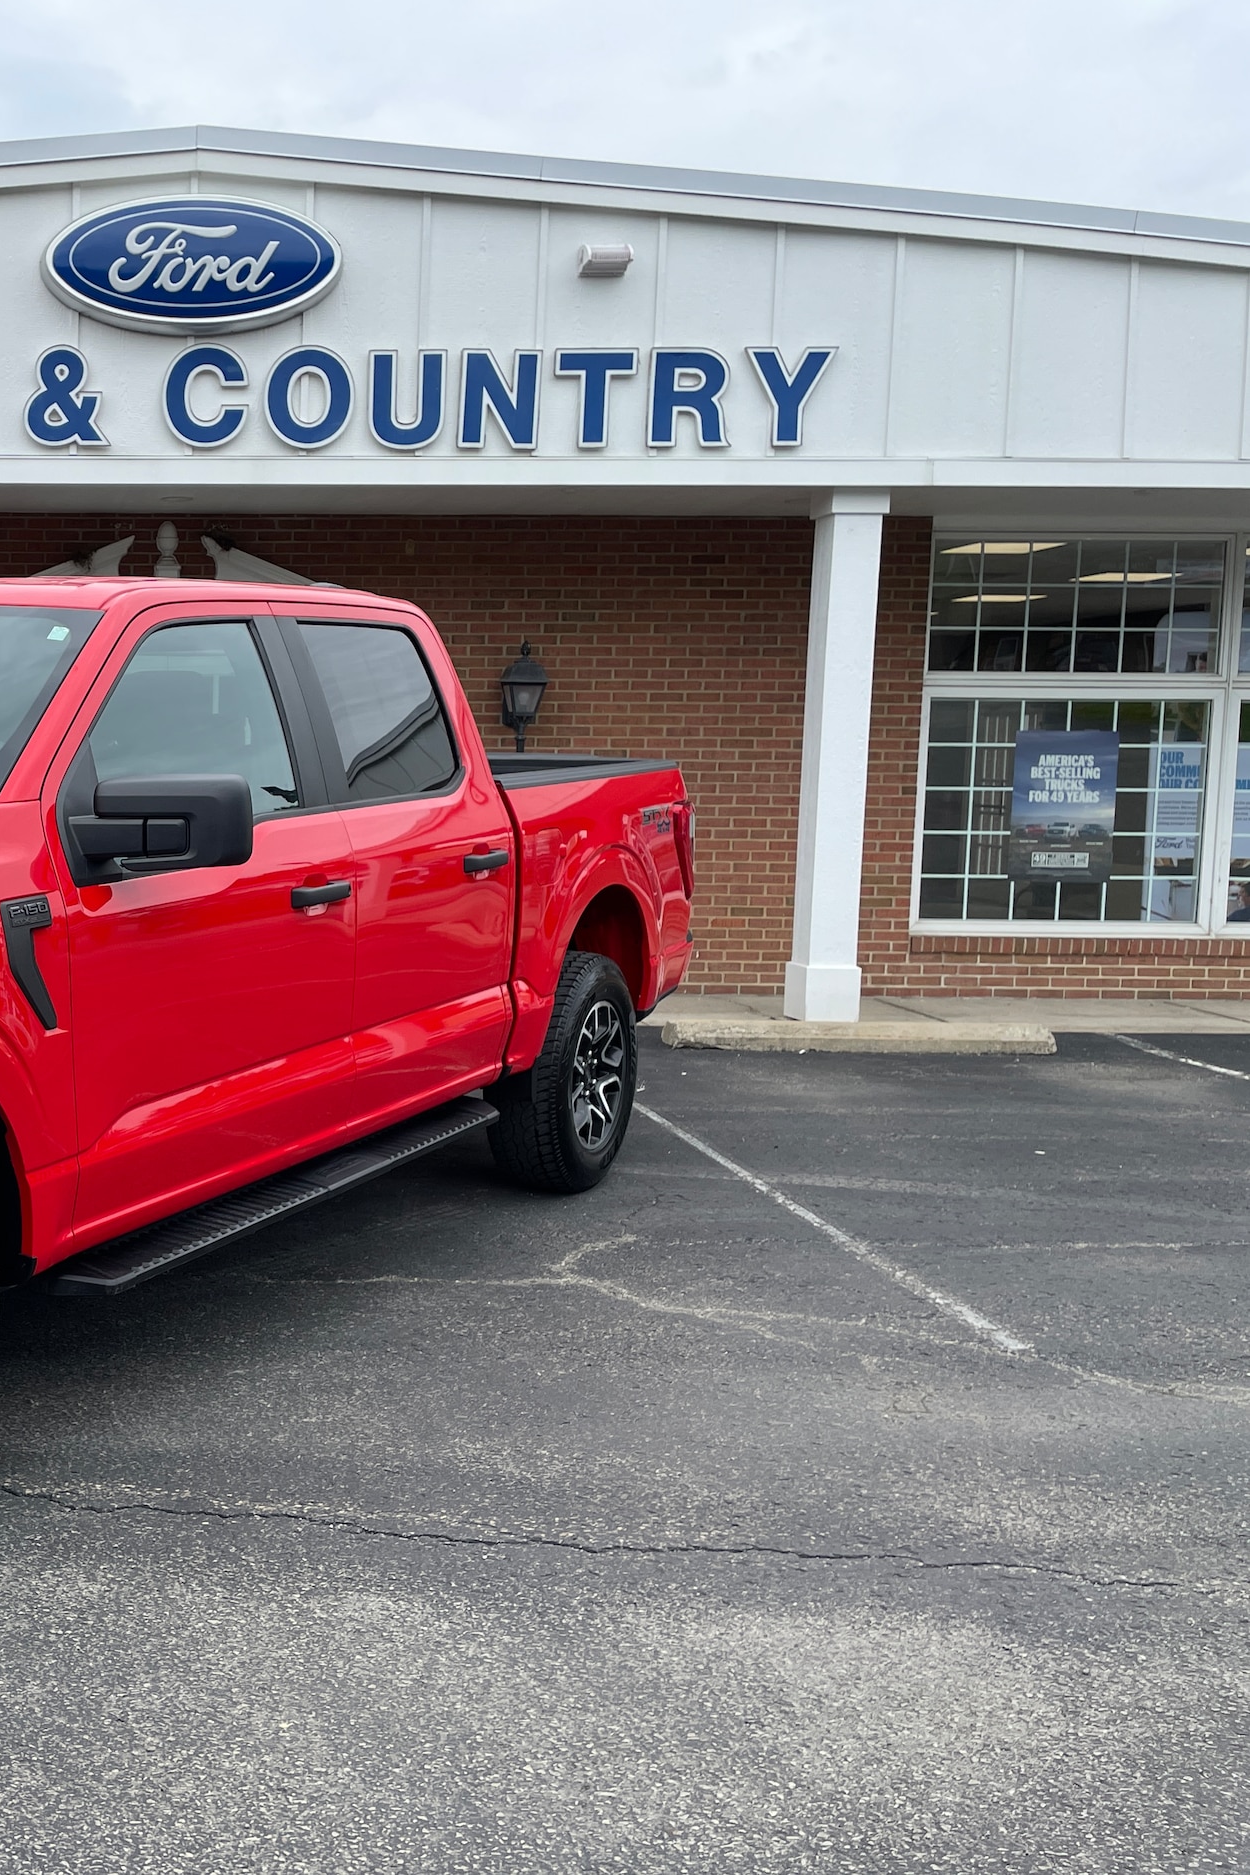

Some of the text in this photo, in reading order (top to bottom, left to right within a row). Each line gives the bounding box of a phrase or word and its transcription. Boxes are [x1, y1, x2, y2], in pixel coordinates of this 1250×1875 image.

[109, 221, 280, 293] Ford
[23, 344, 111, 447] &
[162, 343, 839, 449] COUNTRY
[1038, 754, 1095, 767] AMERICA'S
[1030, 767, 1101, 780] BEST-SELLING
[1044, 778, 1085, 791] TRUCKS
[1029, 790, 1100, 804] FOR 49 YEARS
[9, 901, 49, 918] F-150
